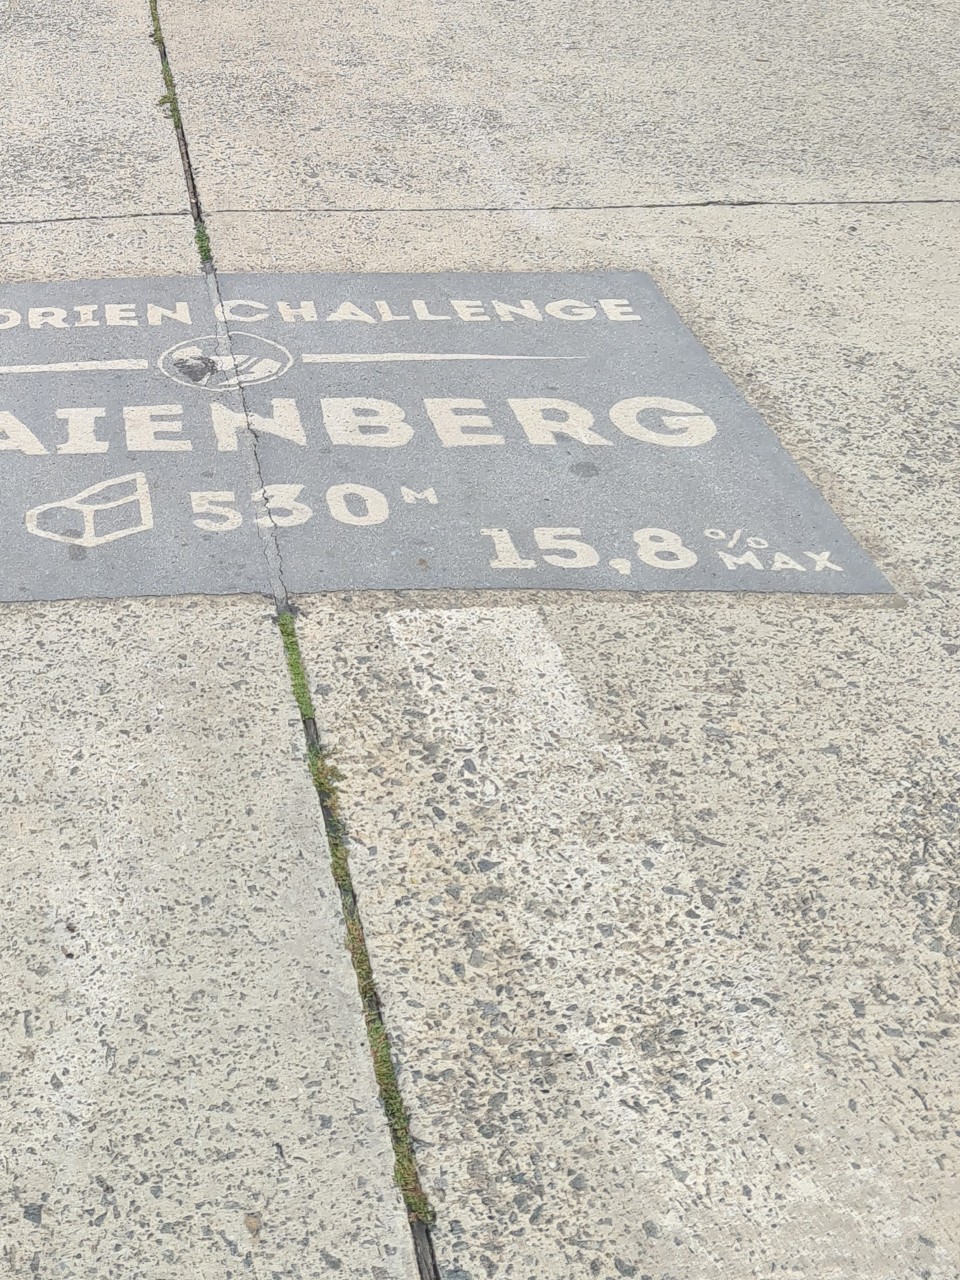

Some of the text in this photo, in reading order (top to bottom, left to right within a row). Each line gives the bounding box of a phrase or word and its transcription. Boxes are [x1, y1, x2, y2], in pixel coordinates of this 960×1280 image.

[213, 298, 643, 325] CHALLENGE
[191, 483, 390, 532] 530
[480, 527, 698, 575] 15,8
[716, 549, 844, 572] MAX
